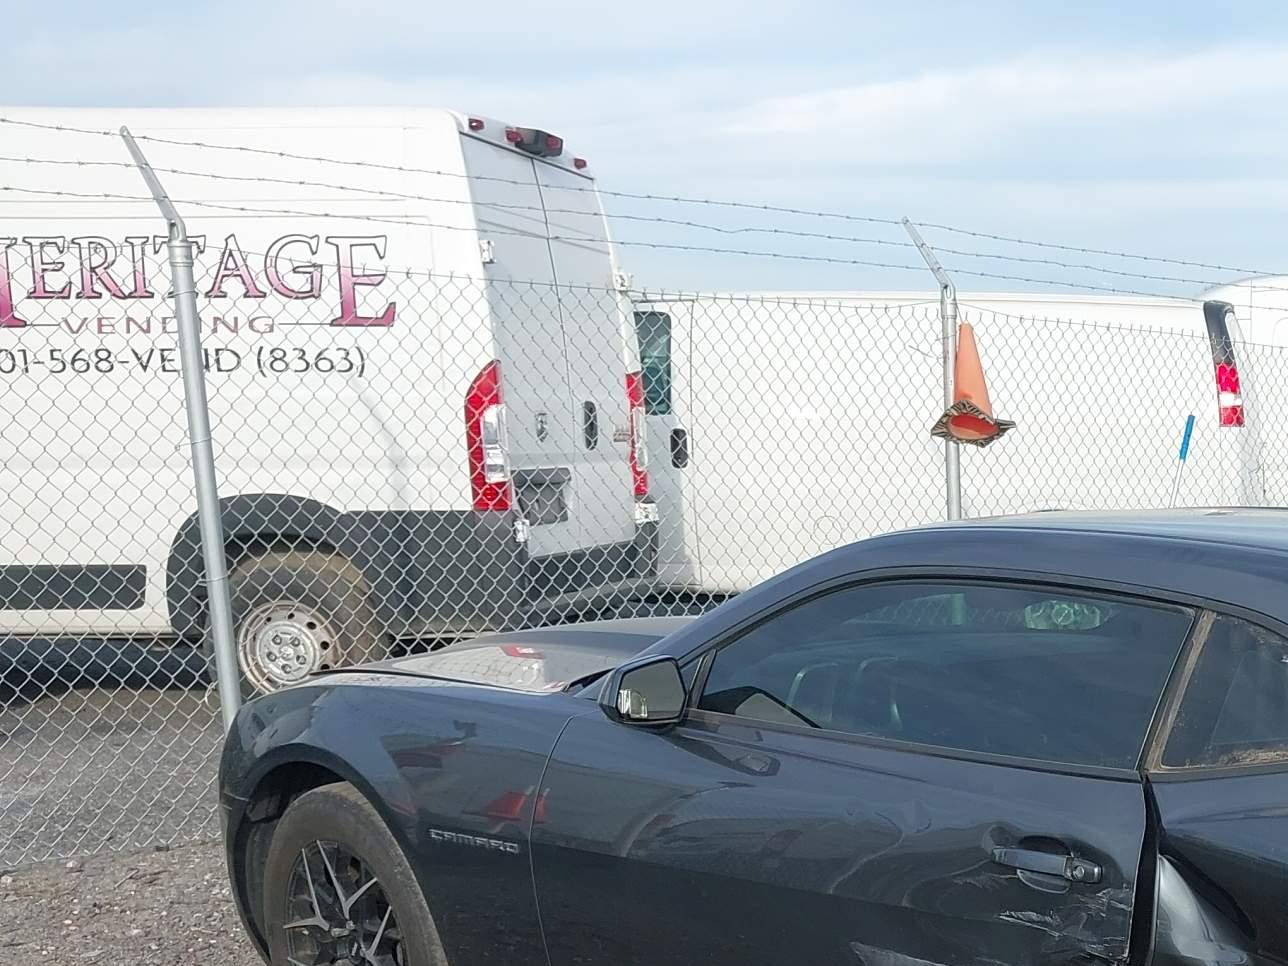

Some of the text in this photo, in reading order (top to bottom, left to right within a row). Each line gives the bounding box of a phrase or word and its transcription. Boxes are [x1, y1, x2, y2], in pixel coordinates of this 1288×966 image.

[0, 233, 397, 329] ERITAGE
[0, 345, 366, 378] 01-568-VED (8363)
[427, 828, 519, 854] CAMARO
